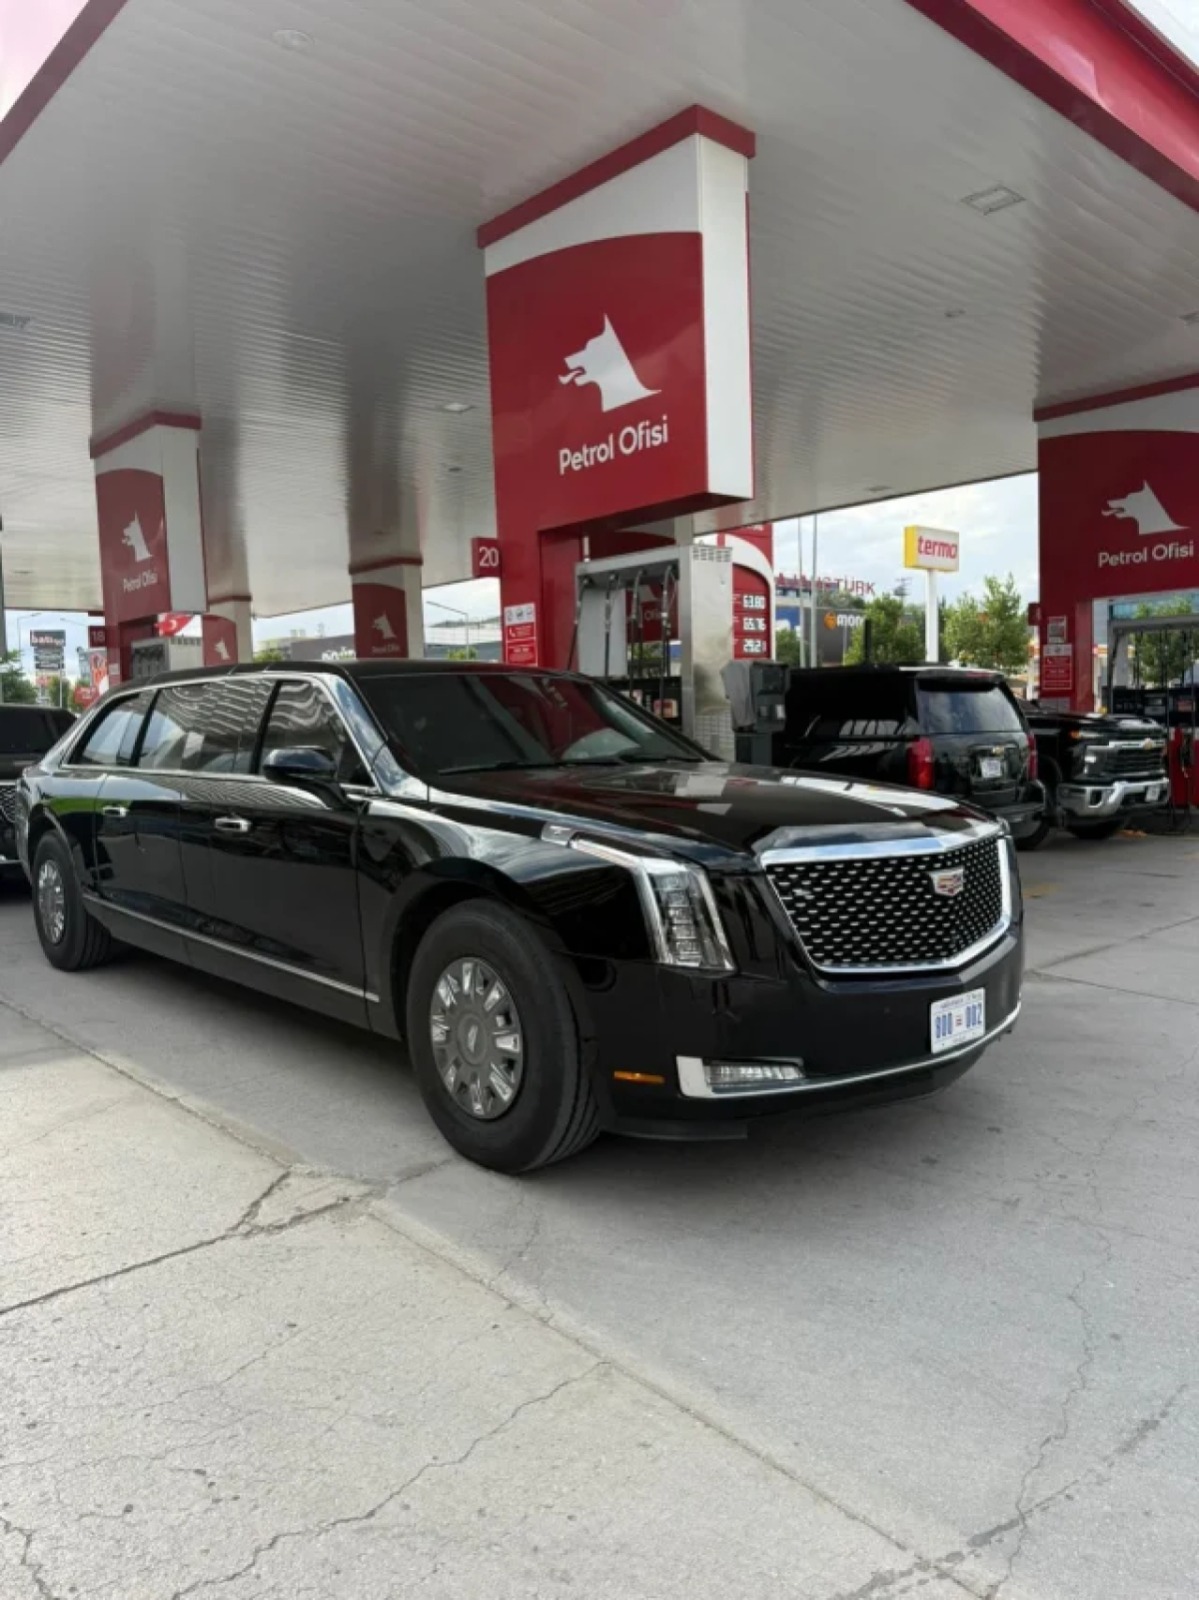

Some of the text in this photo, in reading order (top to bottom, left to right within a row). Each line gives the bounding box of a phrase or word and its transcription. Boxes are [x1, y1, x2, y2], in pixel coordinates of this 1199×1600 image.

[559, 414, 669, 475] Petrol Ofisi
[479, 546, 499, 567] 20
[918, 535, 958, 559] termo
[1098, 540, 1194, 568] Petrol Ofisi
